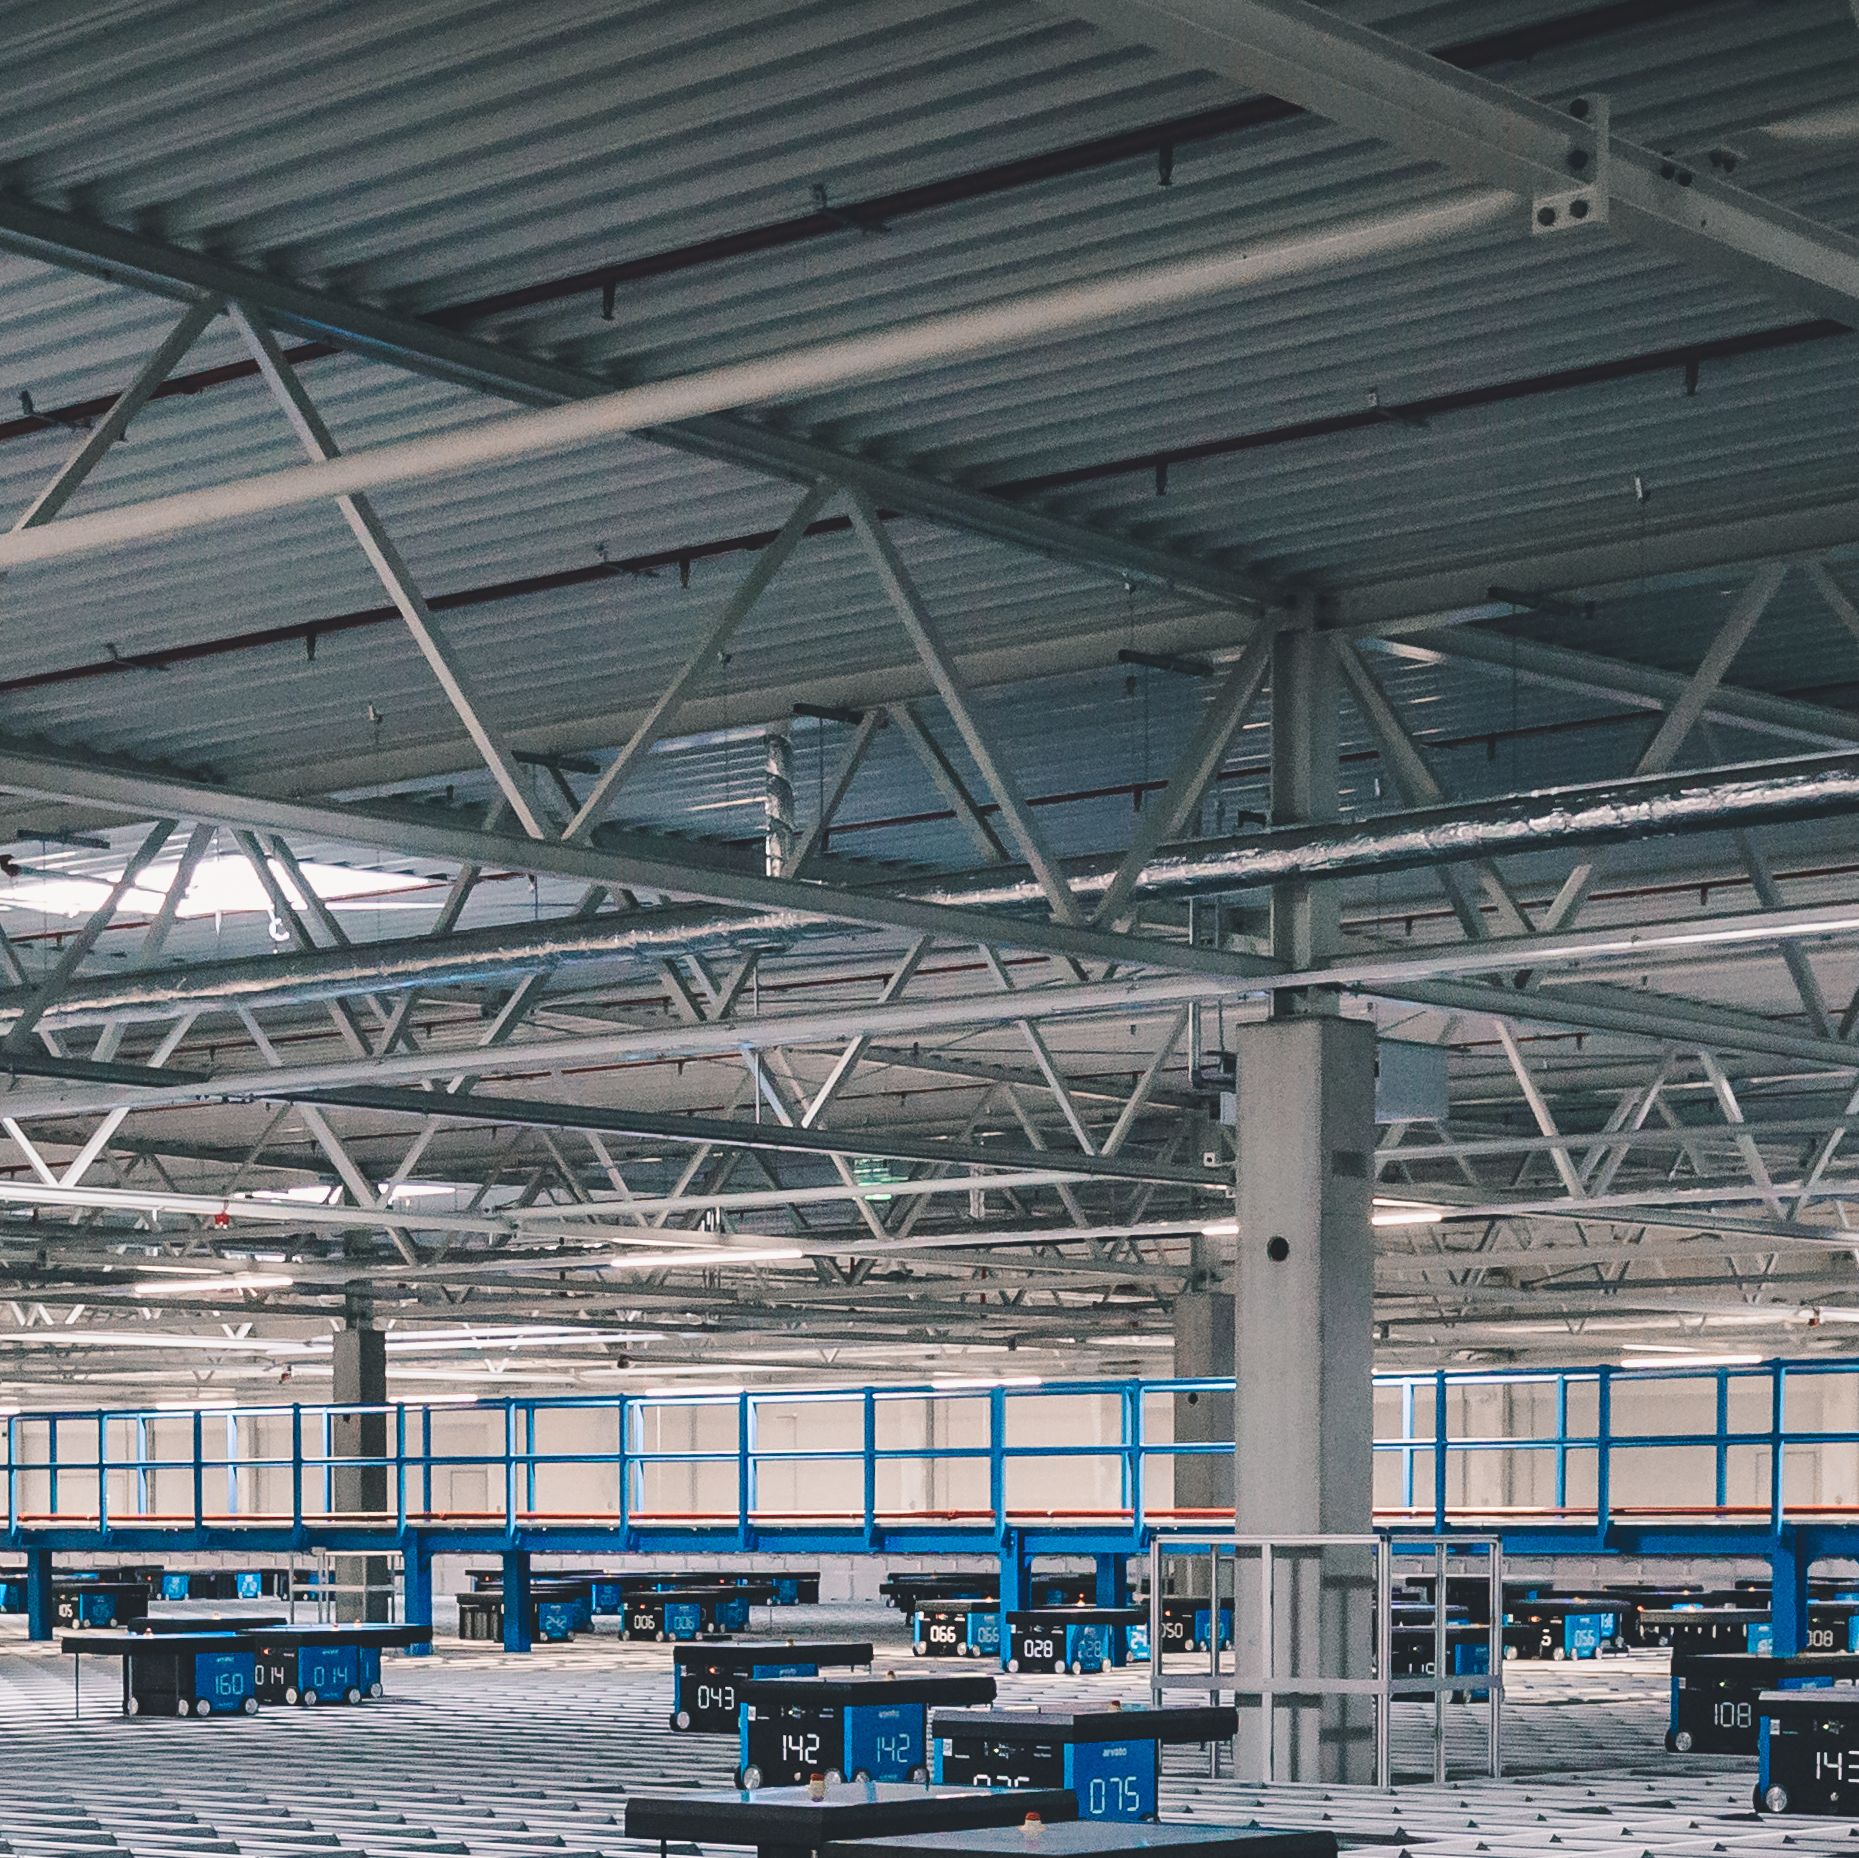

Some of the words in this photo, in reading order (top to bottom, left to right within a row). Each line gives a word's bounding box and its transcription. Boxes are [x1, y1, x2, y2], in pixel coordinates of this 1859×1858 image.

[634, 1615, 655, 1629] 006
[930, 1625, 956, 1643] 066
[1024, 1639, 1053, 1658] 028
[216, 1673, 243, 1695] 160
[255, 1665, 284, 1685] 014
[314, 1667, 347, 1687] 014
[698, 1685, 734, 1710] 043
[1714, 1701, 1751, 1728] 108
[782, 1733, 820, 1765] 142
[877, 1733, 910, 1763] 142
[1090, 1776, 1140, 1813] 075
